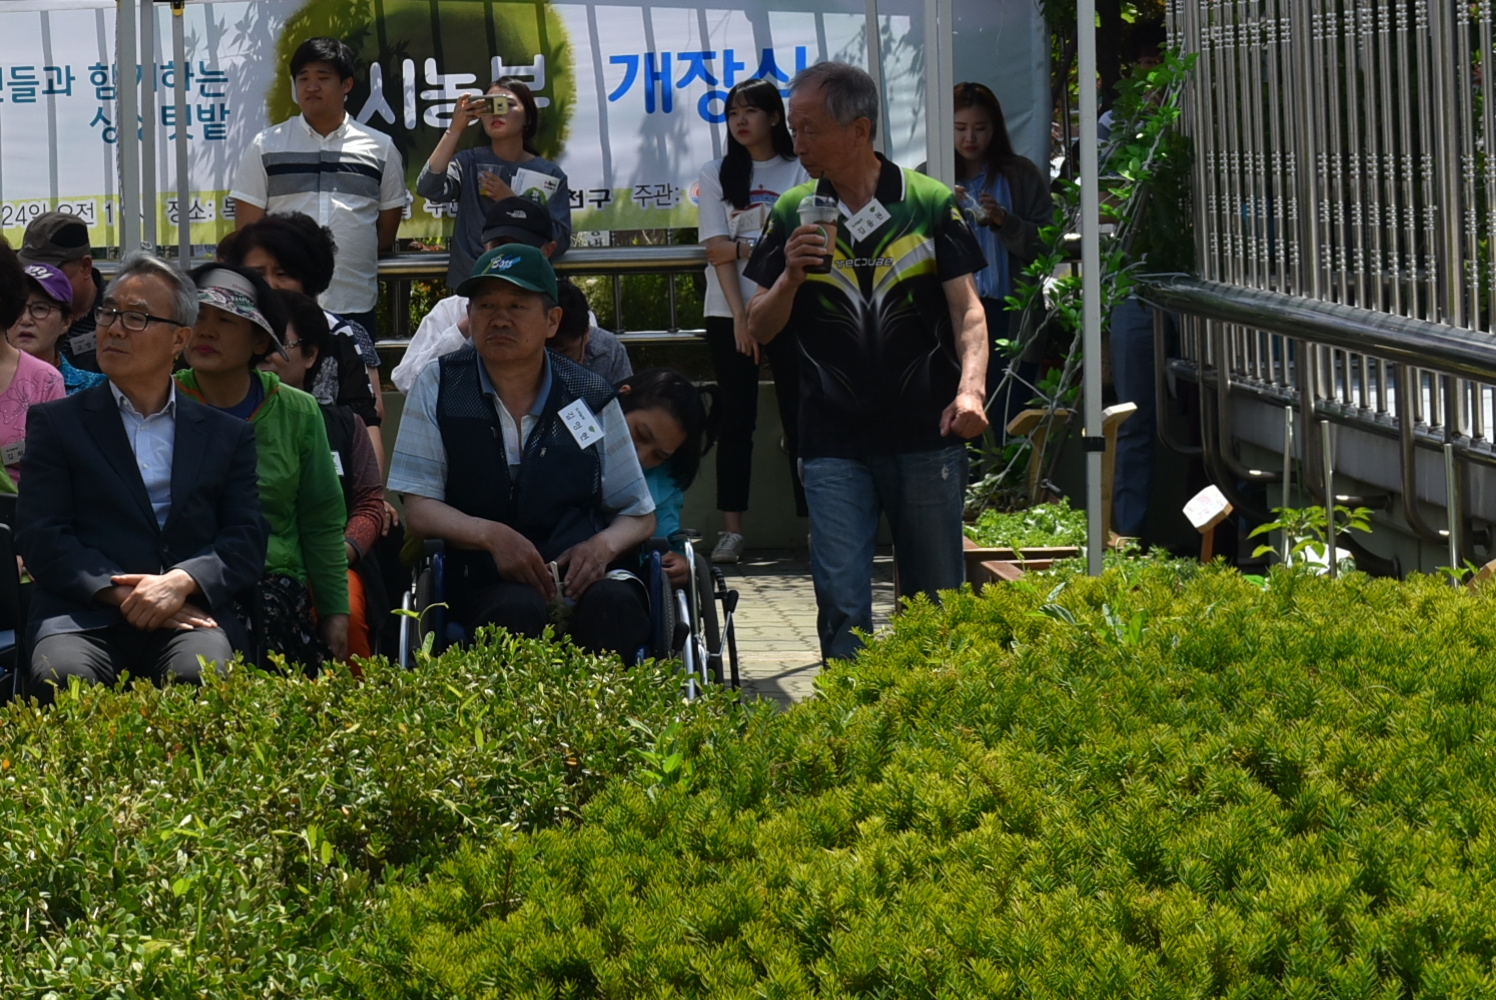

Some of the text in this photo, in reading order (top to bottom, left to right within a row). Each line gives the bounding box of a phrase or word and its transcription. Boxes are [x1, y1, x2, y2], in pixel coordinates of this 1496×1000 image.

[290, 53, 550, 130] 시농부
[89, 103, 231, 144] 상텃밭
[568, 187, 612, 210] 천구
[633, 183, 680, 209] 주관:
